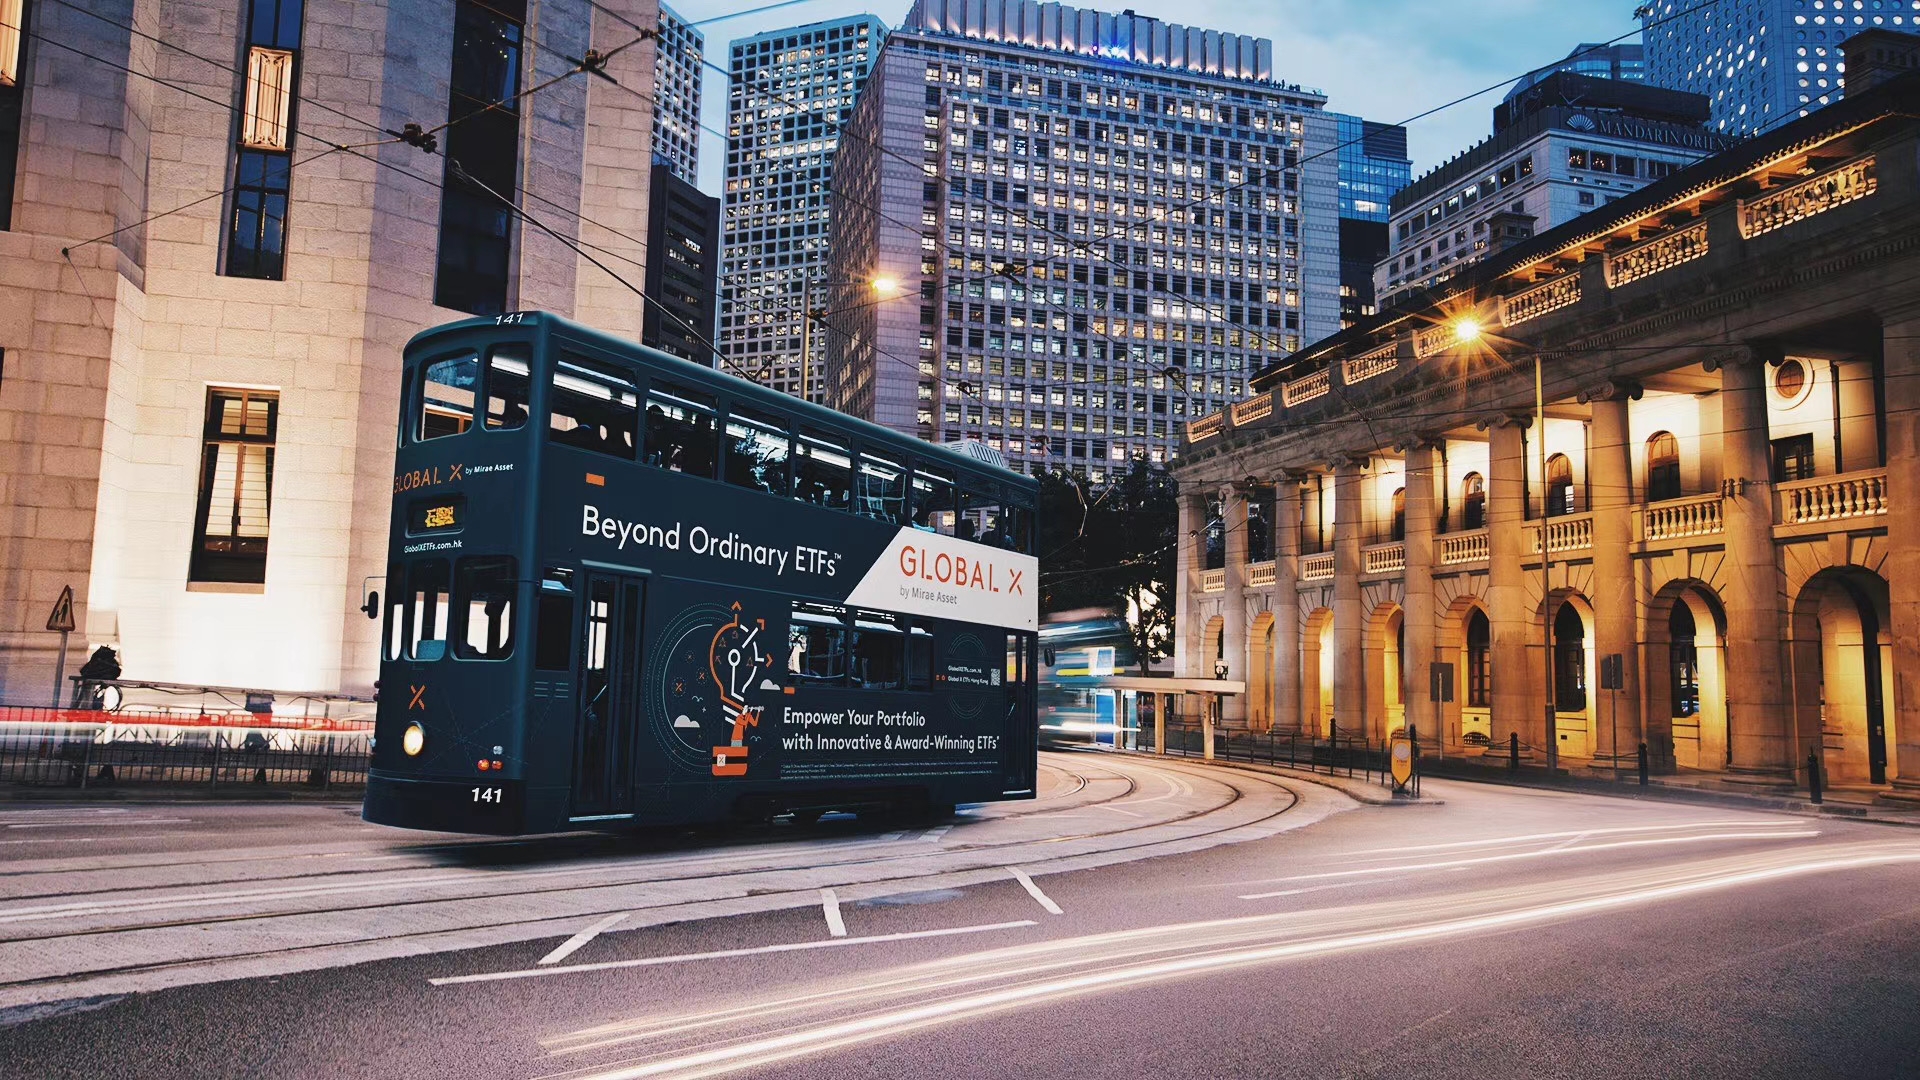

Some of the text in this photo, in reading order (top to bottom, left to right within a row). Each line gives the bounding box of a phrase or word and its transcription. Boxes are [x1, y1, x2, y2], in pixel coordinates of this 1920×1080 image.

[1600, 120, 1680, 145] MANDARIN
[494, 313, 524, 326] 141
[448, 463, 463, 482] X
[465, 468, 474, 476] by
[473, 465, 493, 473] Mirae
[494, 463, 514, 471] Asset
[404, 540, 463, 553] GlobalXETFs.com.hk
[581, 504, 681, 550] Beyond
[688, 526, 789, 576] Ordinary
[899, 545, 1023, 597] GLOBAL X
[899, 584, 958, 605] by Mirae Asset
[783, 706, 926, 730] Empower Your Portfolio
[782, 732, 813, 750] with
[817, 733, 882, 750] Innovative
[884, 734, 893, 750] &
[894, 735, 975, 753] Award-Winning
[471, 787, 503, 804] 141
